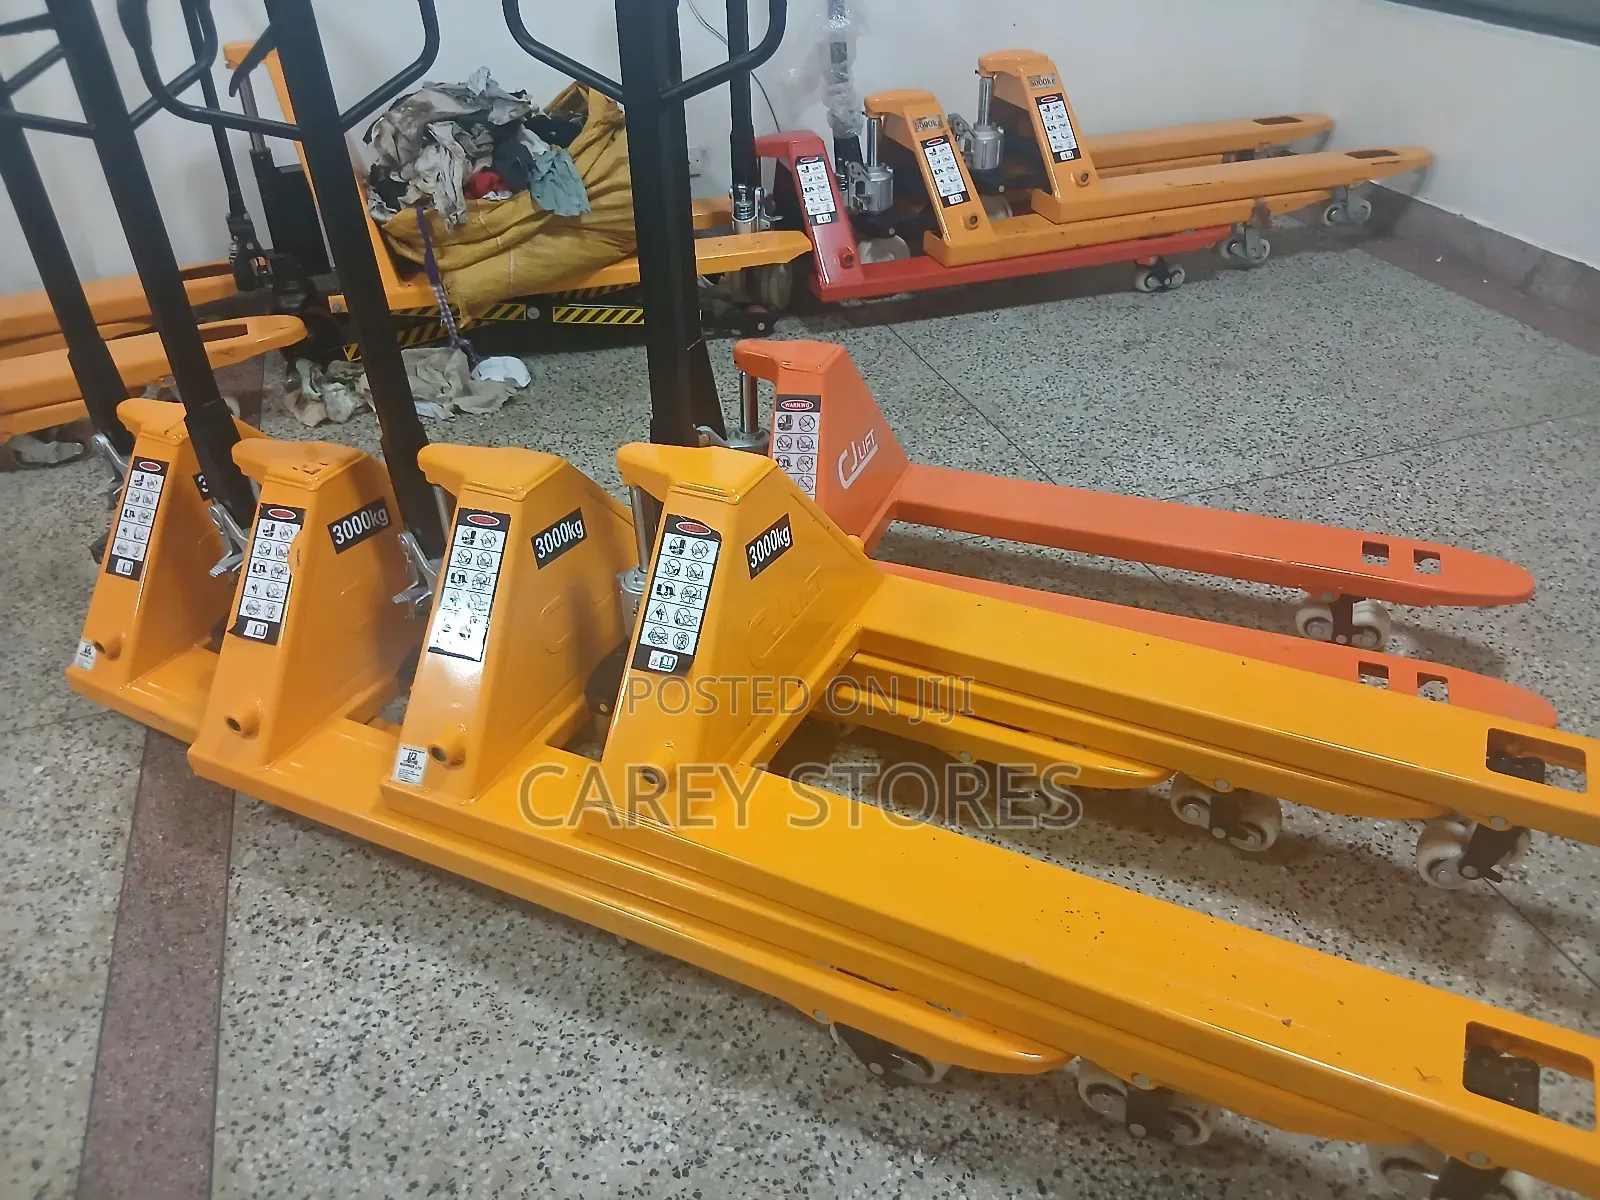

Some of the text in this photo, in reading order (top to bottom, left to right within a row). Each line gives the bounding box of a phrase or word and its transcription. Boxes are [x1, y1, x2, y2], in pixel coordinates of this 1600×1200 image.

[332, 508, 389, 545] 3000kg
[535, 519, 584, 559] 3000kg
[748, 525, 791, 569] 3000kg
